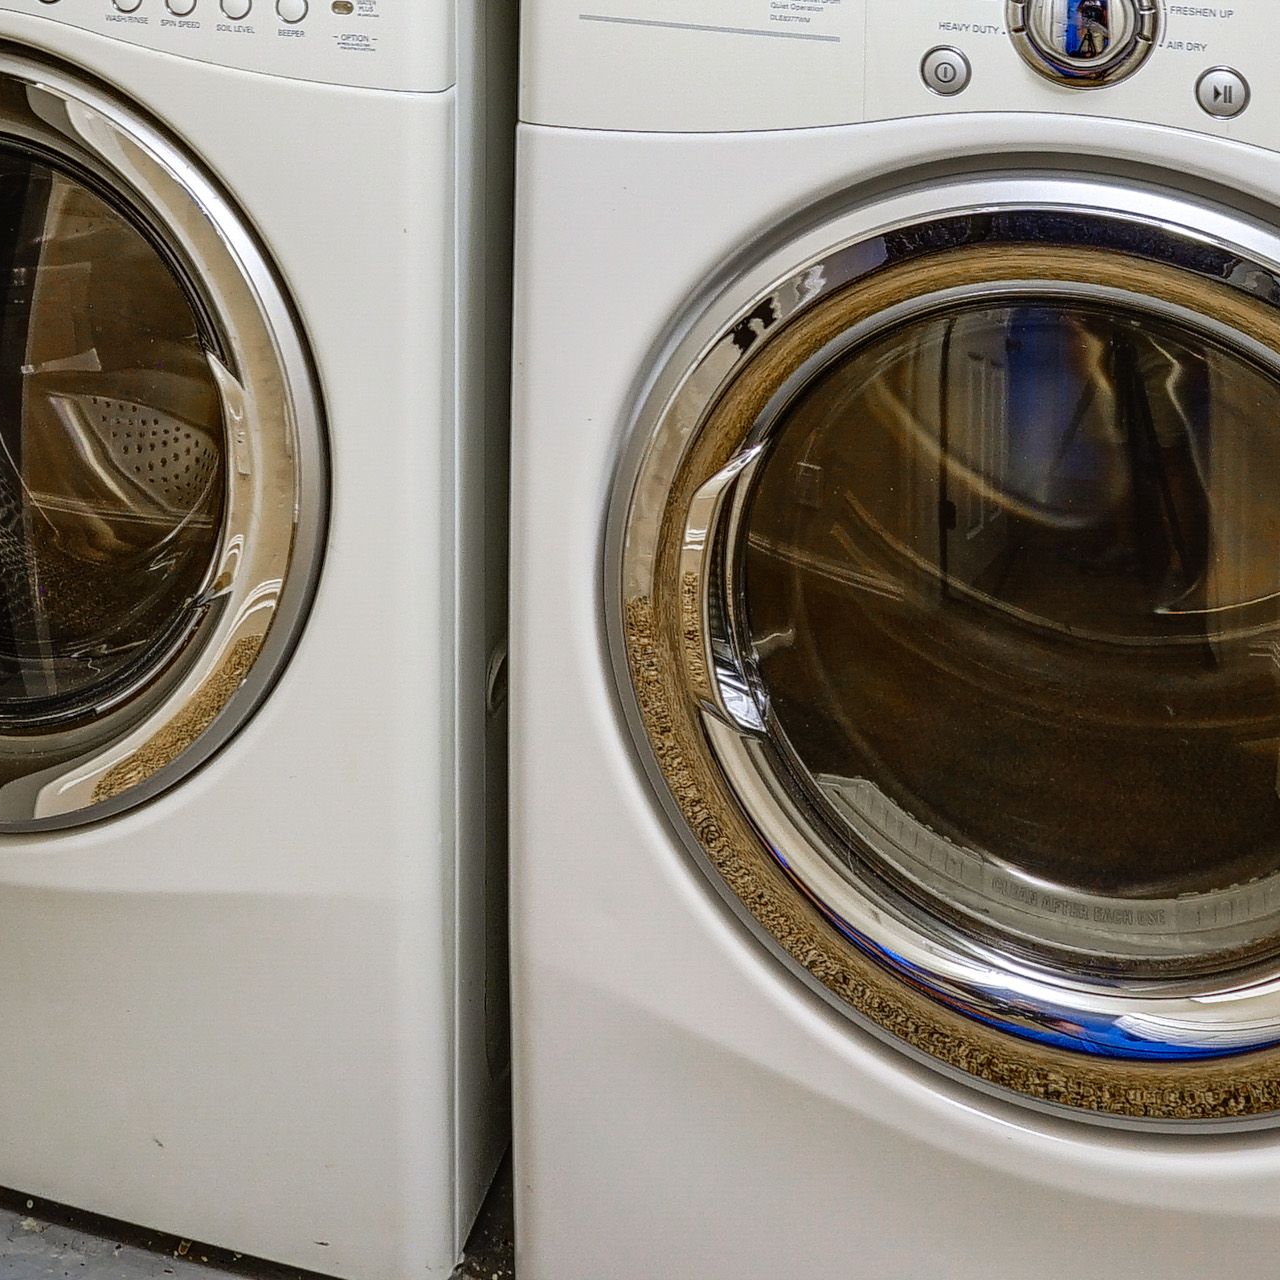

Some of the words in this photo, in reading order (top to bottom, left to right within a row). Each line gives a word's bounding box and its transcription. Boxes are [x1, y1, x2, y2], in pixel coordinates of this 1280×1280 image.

[770, 1, 789, 10] Quiet
[790, 3, 824, 12] Operation
[1169, 5, 1217, 18] FRESHEN
[1219, 8, 1234, 19] UP
[160, 19, 177, 28] SPIN
[178, 20, 200, 29] SPEED
[216, 23, 233, 33] SOIL
[234, 24, 256, 35] LEVEL
[938, 21, 970, 33] HEAVY
[971, 24, 1000, 35] DUTY
[277, 28, 306, 38] BEEPER
[340, 33, 370, 42] OPTION
[1166, 40, 1184, 51] AIR
[1185, 41, 1208, 52] DRY
